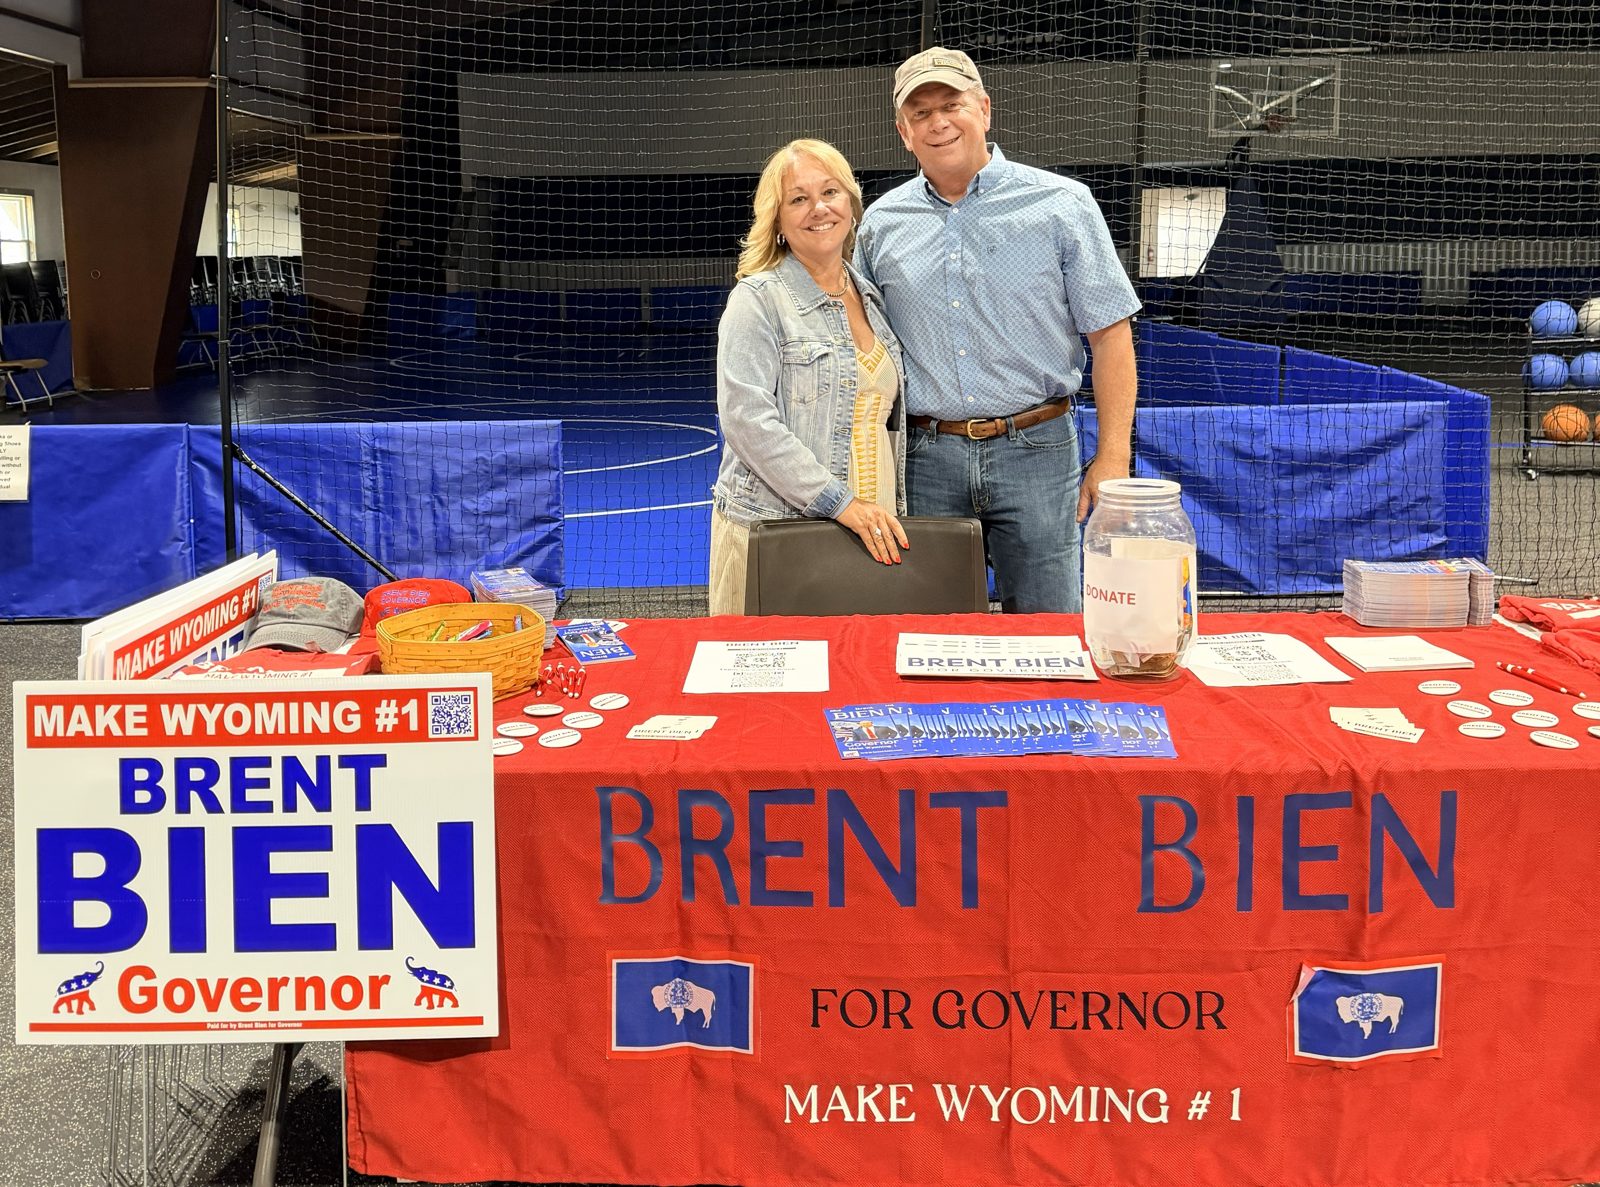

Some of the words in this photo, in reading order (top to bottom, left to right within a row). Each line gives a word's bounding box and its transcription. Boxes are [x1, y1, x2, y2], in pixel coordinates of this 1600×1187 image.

[1086, 584, 1137, 606] DONATE
[115, 634, 166, 680] MAKE
[169, 595, 240, 657] WYOMING
[241, 584, 258, 616] #1
[580, 647, 624, 658] BIEN
[907, 657, 1008, 668] BRENT
[1014, 656, 1086, 669] BIEN
[33, 703, 148, 738] MAKE
[159, 701, 362, 737] WYOMING
[374, 698, 420, 733] #1
[833, 708, 884, 721] BIEN
[118, 753, 388, 815] BRENT
[595, 786, 1008, 909] BRENT
[1136, 790, 1458, 913] BIEN
[35, 821, 476, 955] BIEN
[117, 964, 392, 1015] Governor
[810, 988, 914, 1030] FOR
[931, 989, 1228, 1031] GOVERNOR
[206, 1022, 220, 1030] Paid
[220, 1022, 229, 1030] for
[229, 1022, 237, 1030] by
[783, 1083, 916, 1124] MAKE
[931, 1083, 1170, 1125] WYOMING
[1187, 1091, 1212, 1121] #
[1229, 1087, 1242, 1122] 1
